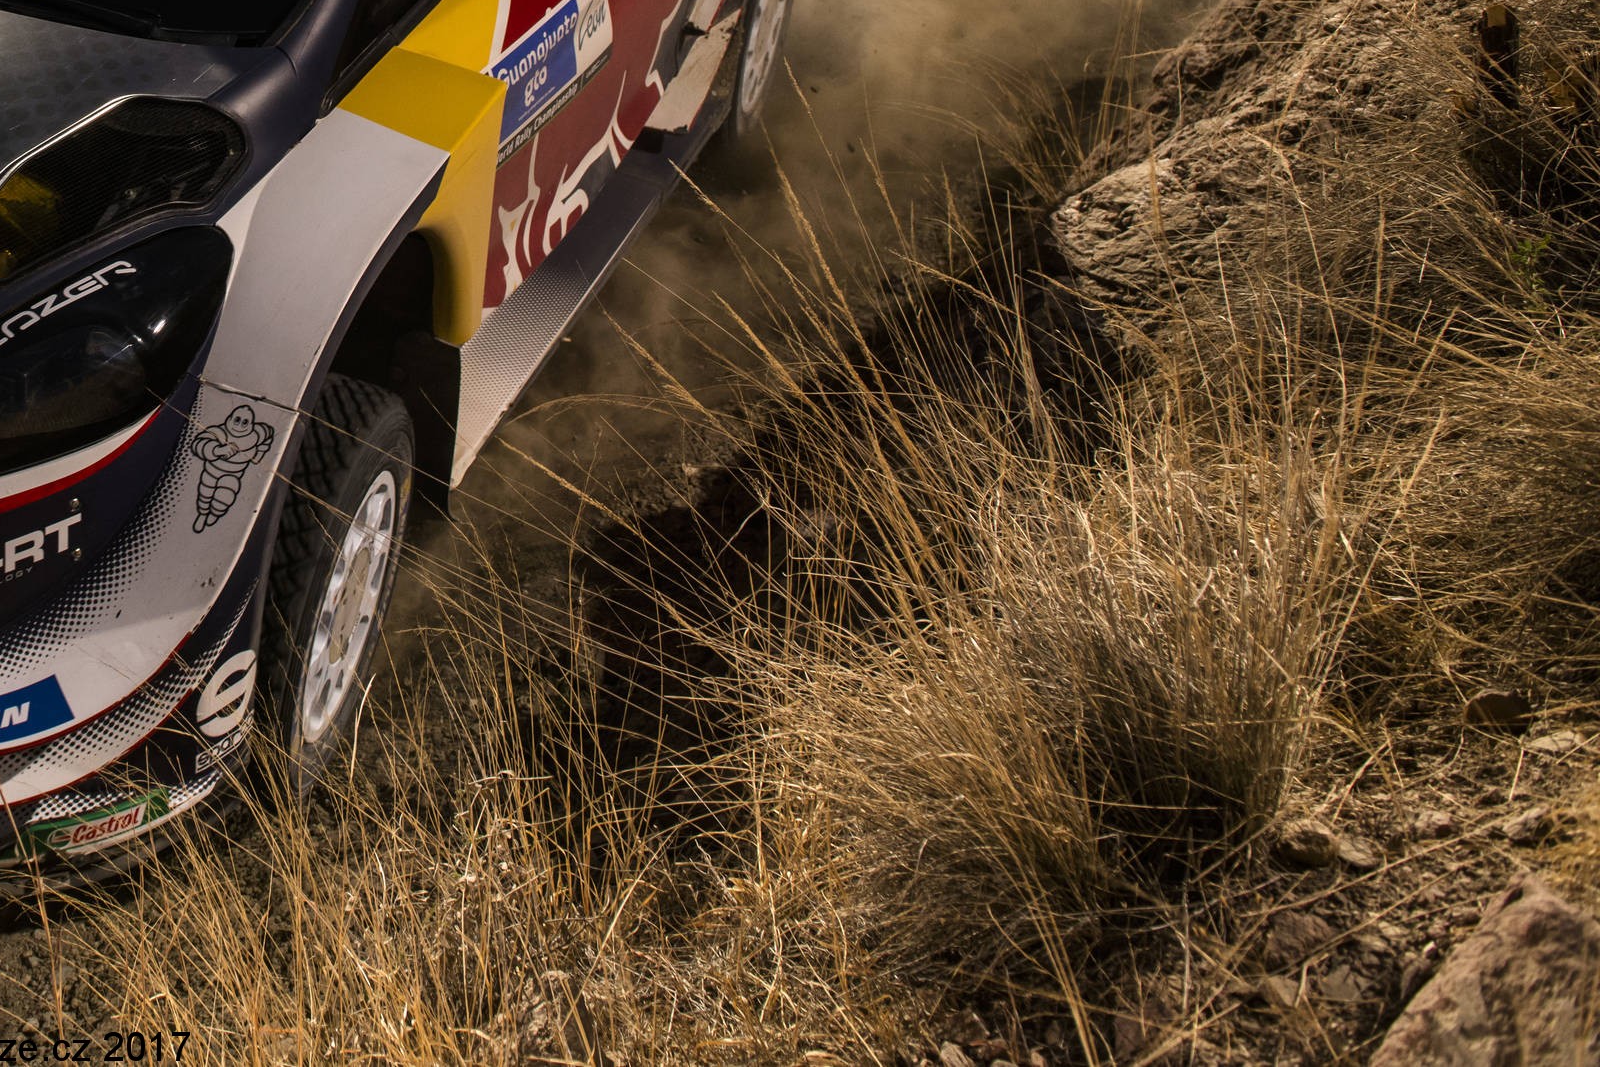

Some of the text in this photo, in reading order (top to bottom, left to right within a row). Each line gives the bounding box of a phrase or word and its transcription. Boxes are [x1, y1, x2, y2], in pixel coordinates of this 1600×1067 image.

[523, 65, 548, 107] gto
[498, 144, 514, 164] orld
[70, 807, 140, 844] Castrol
